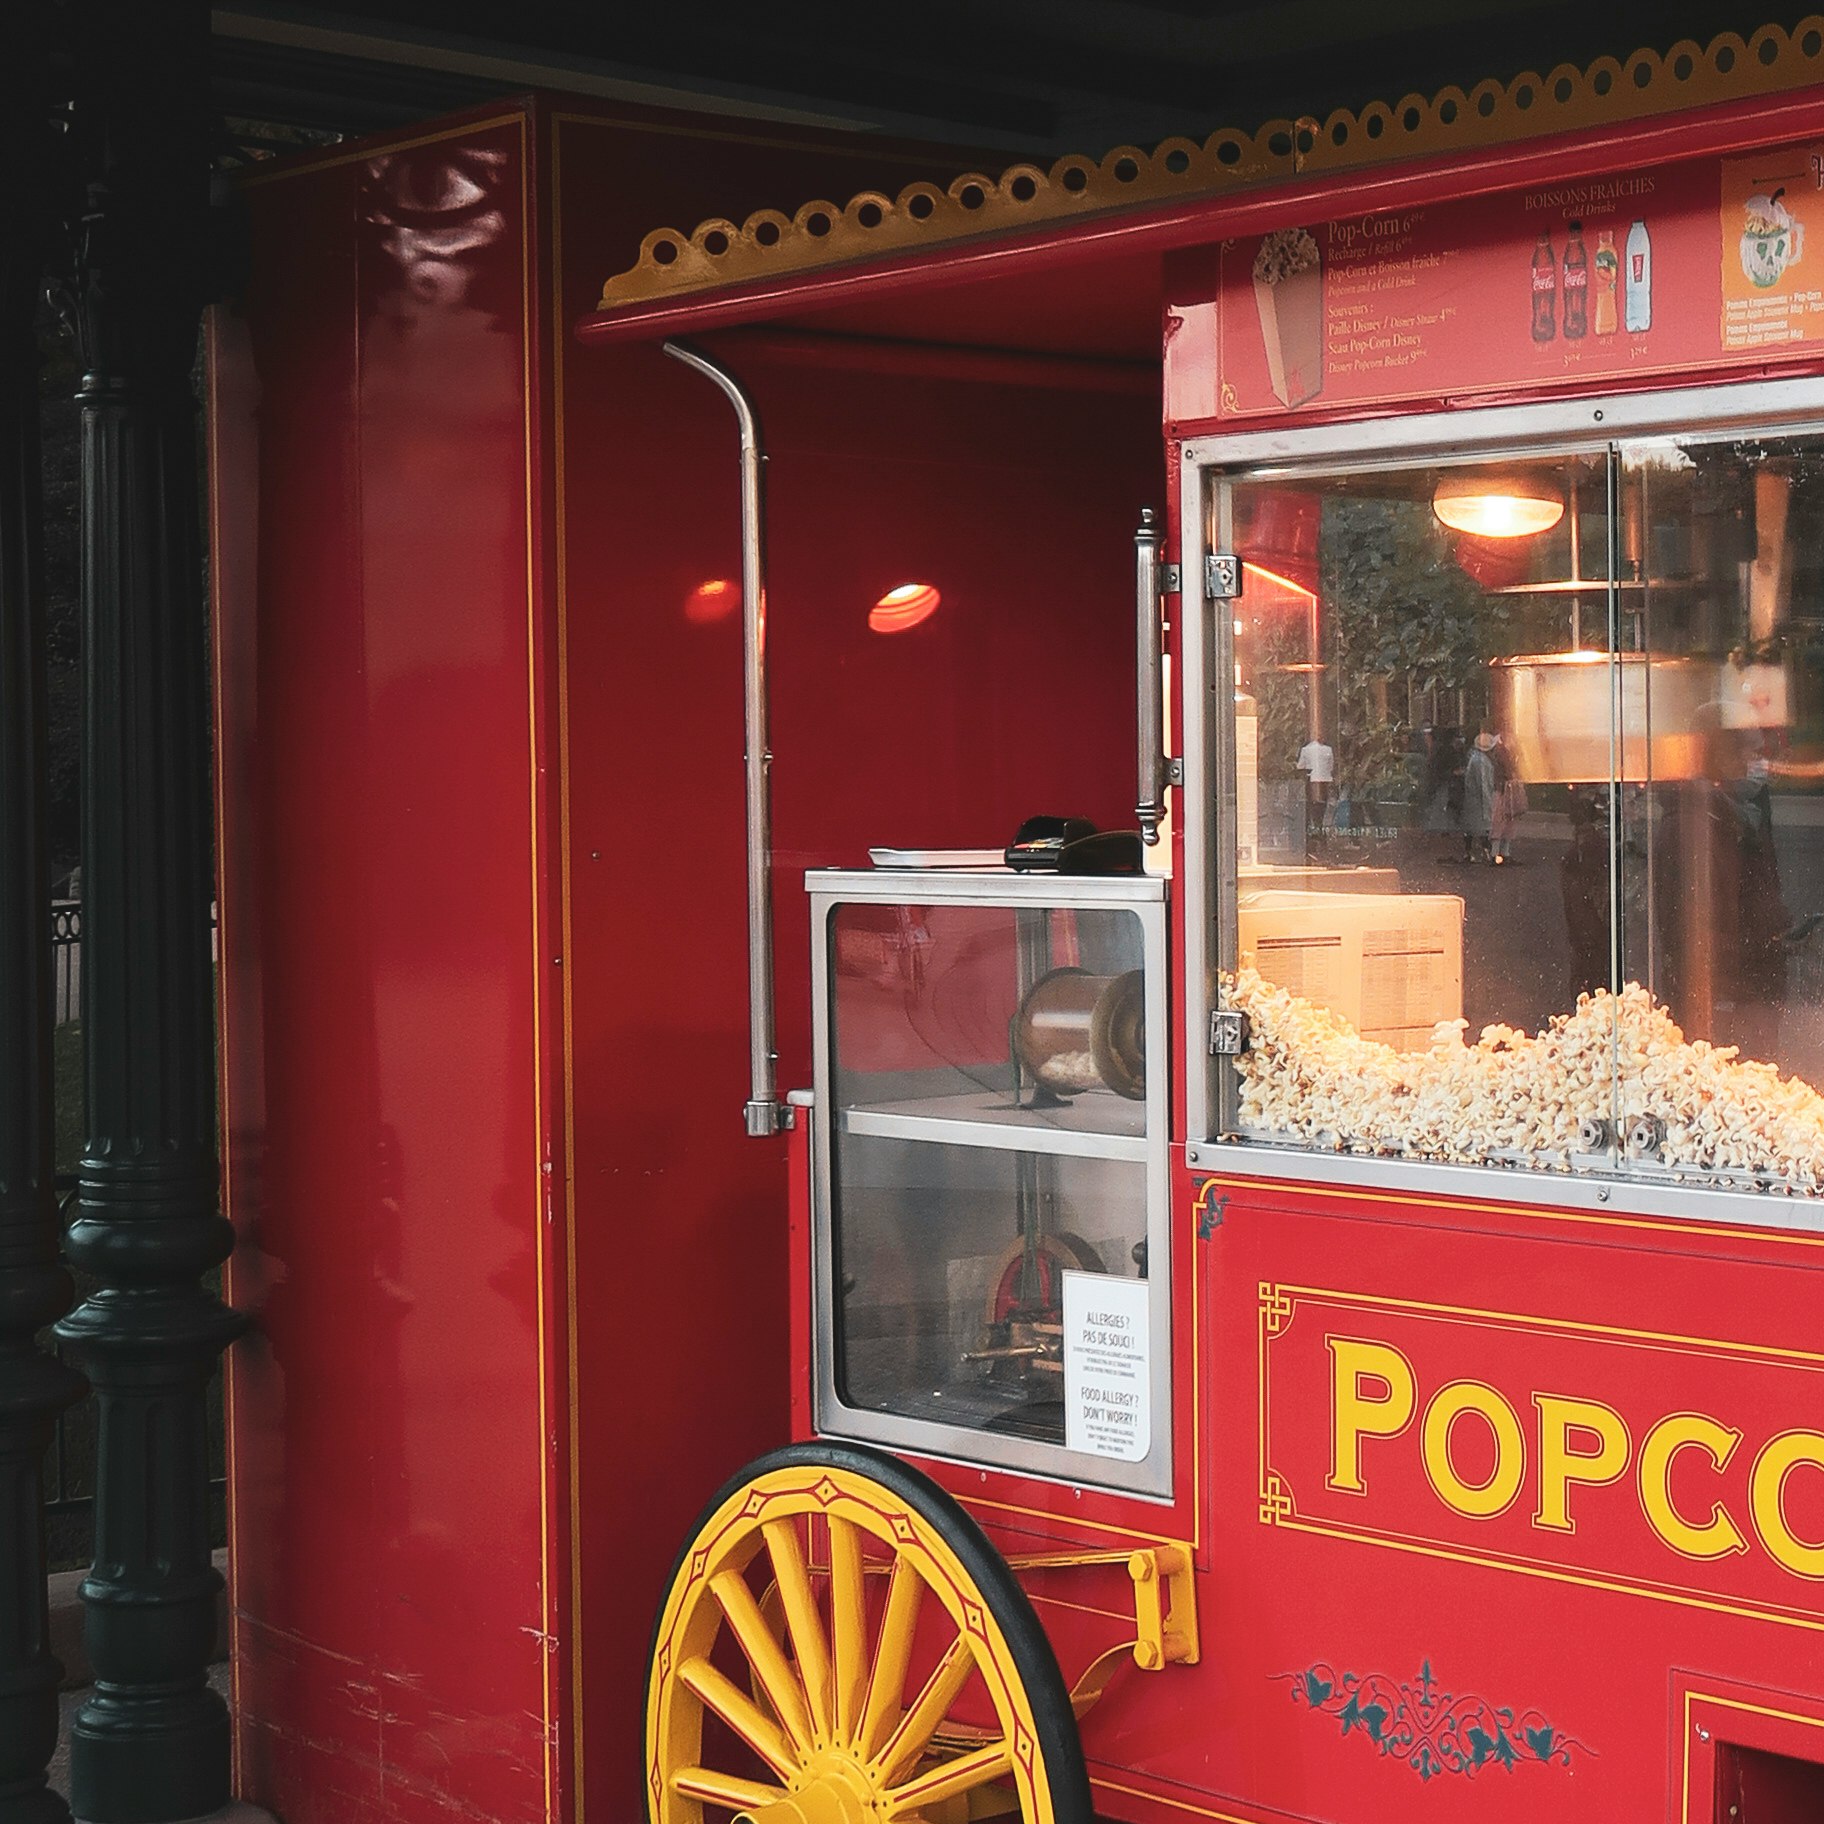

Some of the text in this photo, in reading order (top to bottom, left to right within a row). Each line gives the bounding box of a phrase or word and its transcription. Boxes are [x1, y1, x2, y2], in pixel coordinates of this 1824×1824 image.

[1525, 187, 1587, 210] BOISSONS
[1562, 200, 1616, 218] Cold Drinks
[1328, 214, 1399, 247] Pop-Corn
[1328, 246, 1366, 261] Recharge
[1328, 265, 1367, 283] Pop-Corn
[1369, 264, 1377, 276] et
[1378, 259, 1410, 273] Boisson
[1378, 276, 1395, 290] Cold
[1329, 320, 1351, 336] Paille
[1353, 318, 1380, 333] Disney
[1350, 335, 1391, 354] Pop-Corn
[1393, 332, 1421, 347] Disney
[1086, 1311, 1124, 1328] ALLERGIES
[1083, 1329, 1096, 1343] PAS
[1098, 1331, 1107, 1345] DE
[1081, 1386, 1100, 1401] FOOD
[1102, 1390, 1133, 1406] ALLERGY
[1083, 1405, 1105, 1421] DON'T
[1106, 1409, 1133, 1425] WORRY
